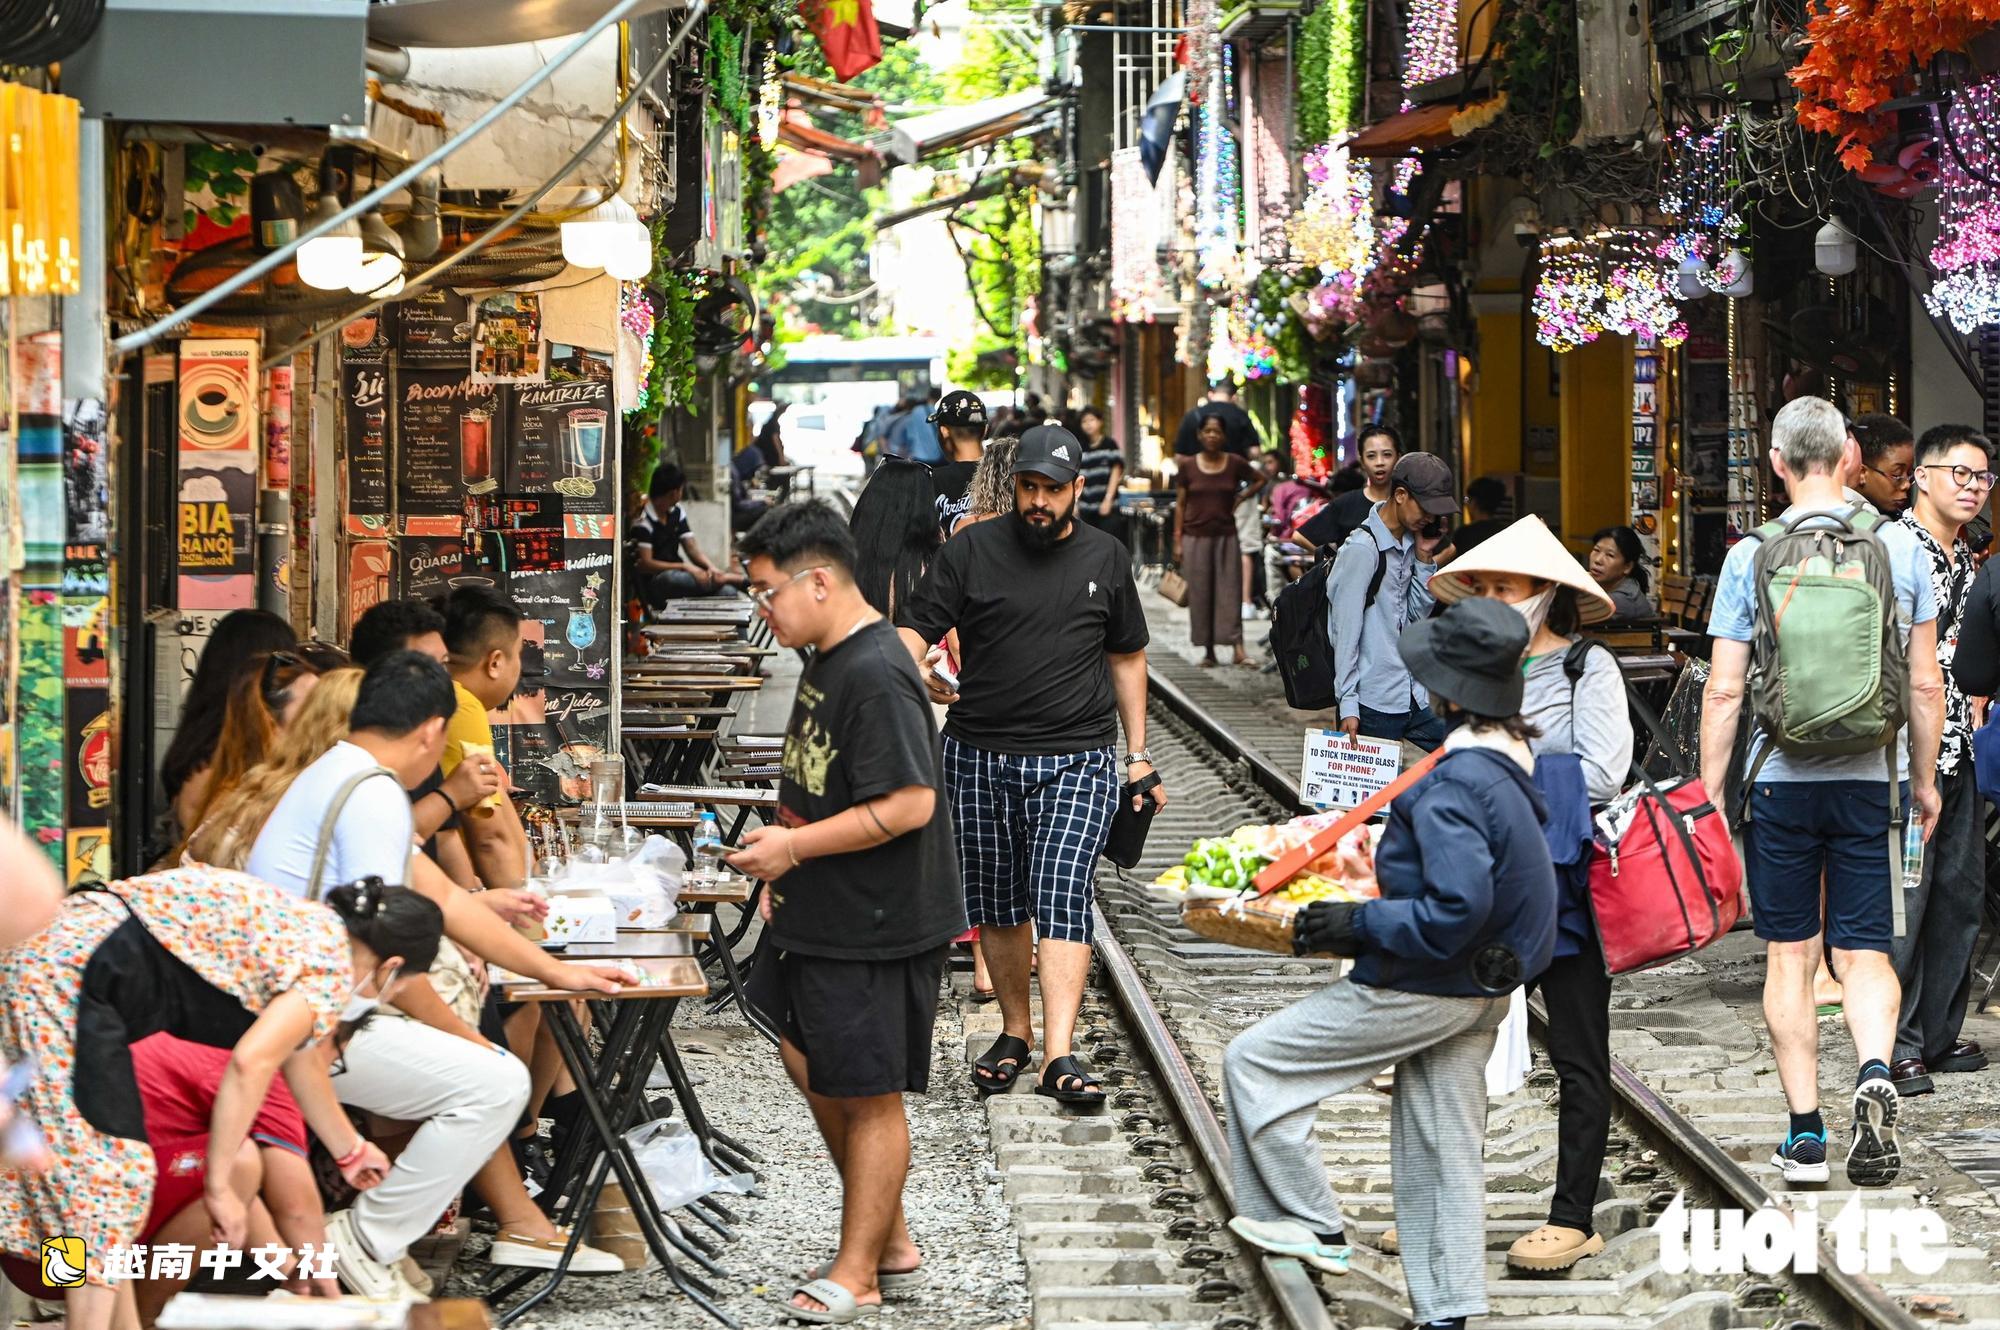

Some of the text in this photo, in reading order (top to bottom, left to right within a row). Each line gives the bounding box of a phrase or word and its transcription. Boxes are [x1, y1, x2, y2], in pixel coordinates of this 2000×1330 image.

[210, 350, 249, 358] ESPRESSO
[519, 384, 608, 407] KAMIKAZE
[178, 503, 234, 534] BIA
[560, 692, 604, 721] Julep
[1328, 740, 1339, 749] DO
[1358, 744, 1382, 755] WANT
[1310, 748, 1396, 768] TO STICK TEMPERED GLASS
[1327, 761, 1377, 776] FOR PHONE?
